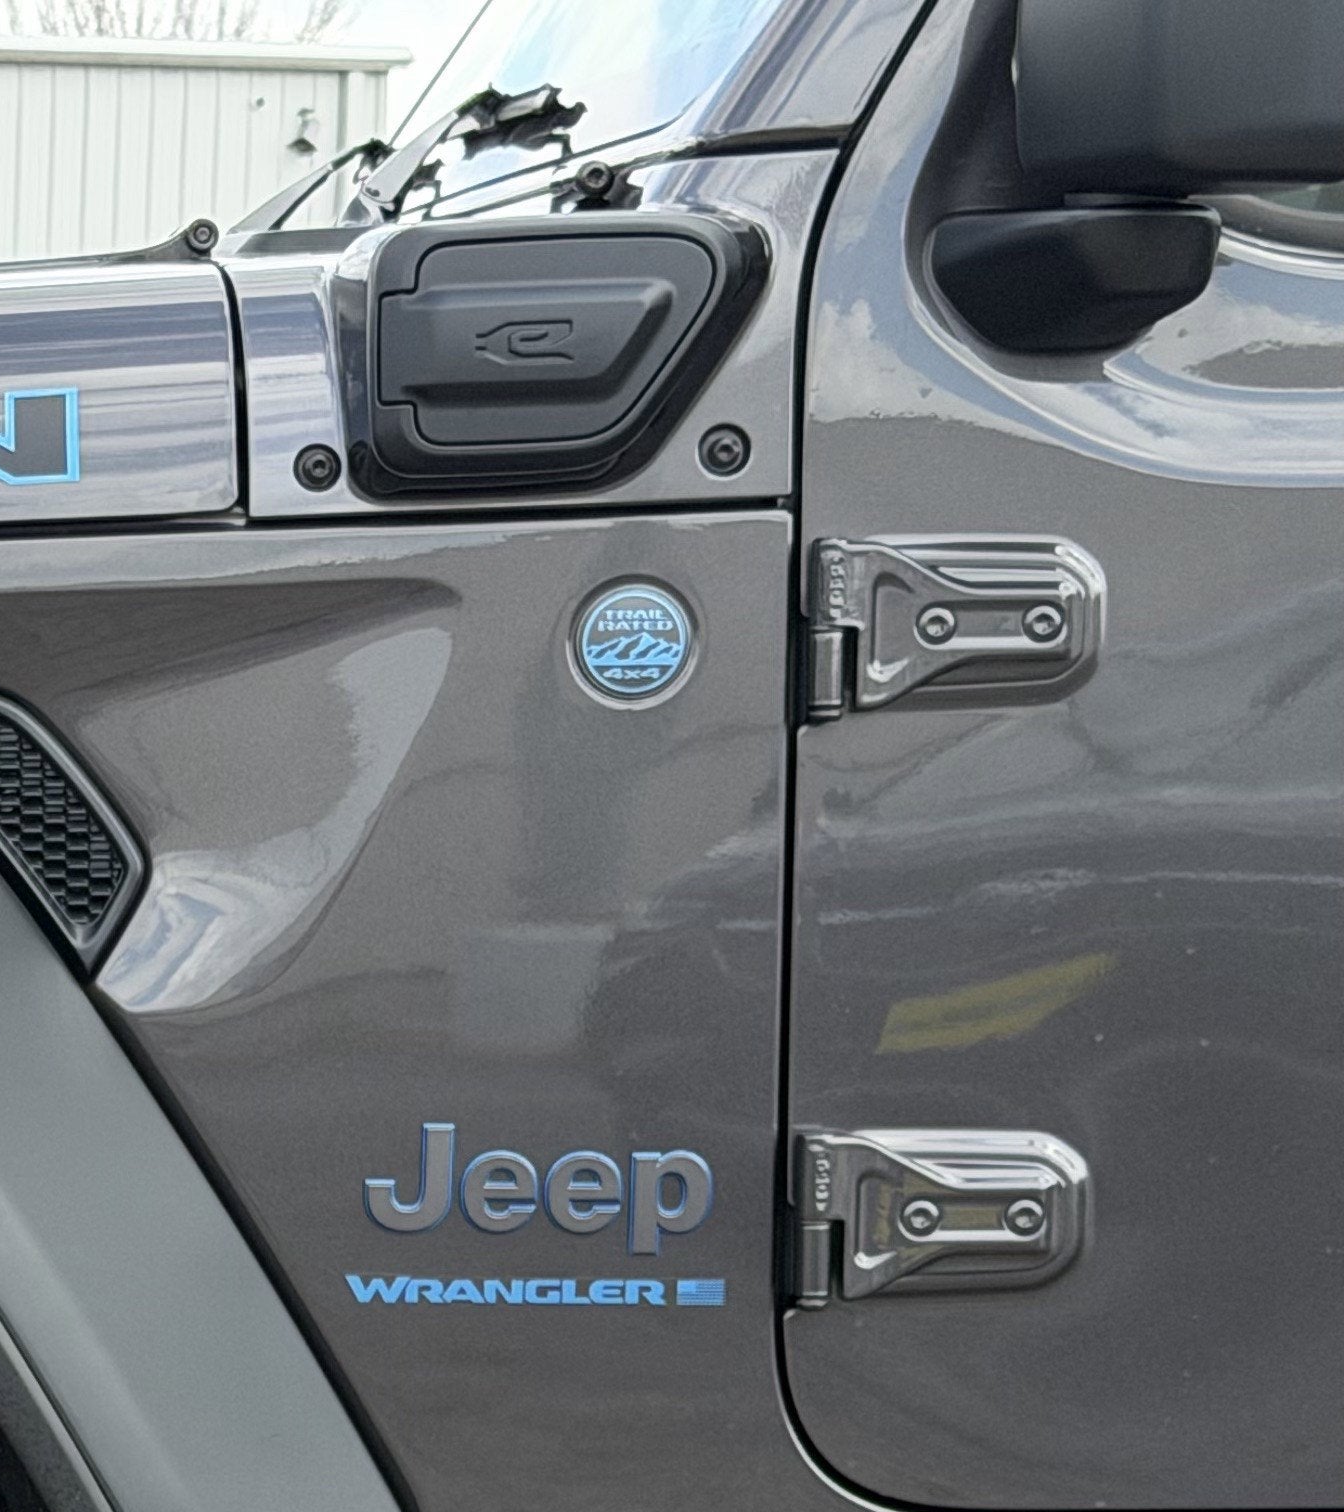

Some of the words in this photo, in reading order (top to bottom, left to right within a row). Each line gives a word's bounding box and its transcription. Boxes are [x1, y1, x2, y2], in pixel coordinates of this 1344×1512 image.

[597, 619, 673, 632] RATED
[605, 608, 668, 621] TRAIL
[364, 1121, 714, 1256] Jeep
[344, 1273, 667, 1306] WRANGLER
